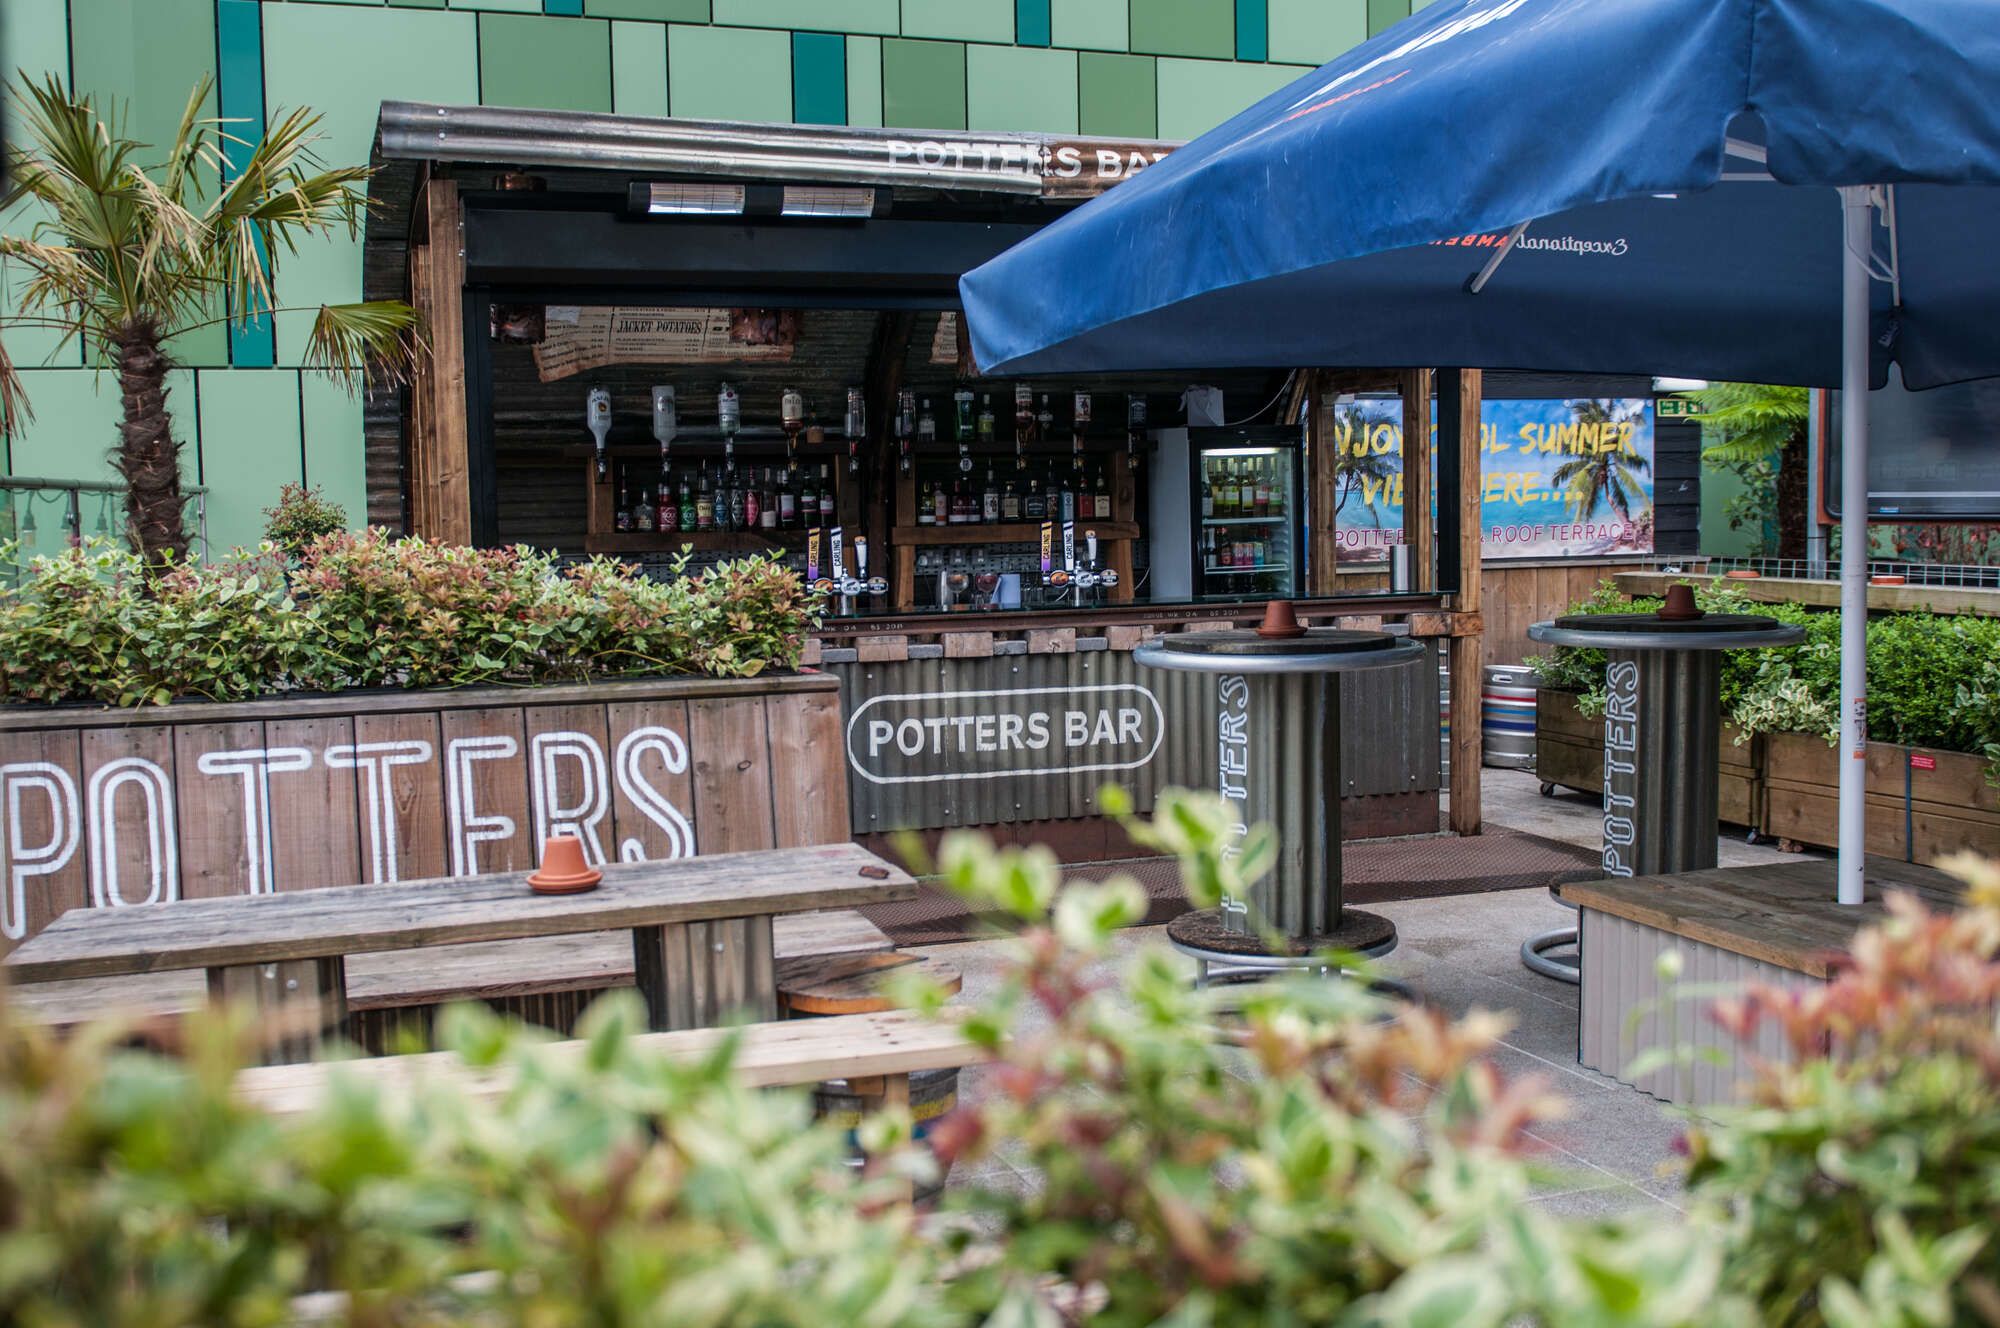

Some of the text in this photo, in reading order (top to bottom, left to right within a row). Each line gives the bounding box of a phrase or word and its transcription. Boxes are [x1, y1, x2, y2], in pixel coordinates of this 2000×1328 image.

[886, 140, 1168, 178] POTTERS BA
[616, 320, 702, 334] JACKET POTATOES
[1519, 422, 1636, 456] SUMMER
[833, 539, 842, 567] CARLING
[1335, 523, 1634, 547] POTTER ROOF TERRACE
[869, 708, 1143, 757] POTTERS BAR
[1602, 661, 1638, 878] POTTERS
[0, 726, 694, 940] POTTERS
